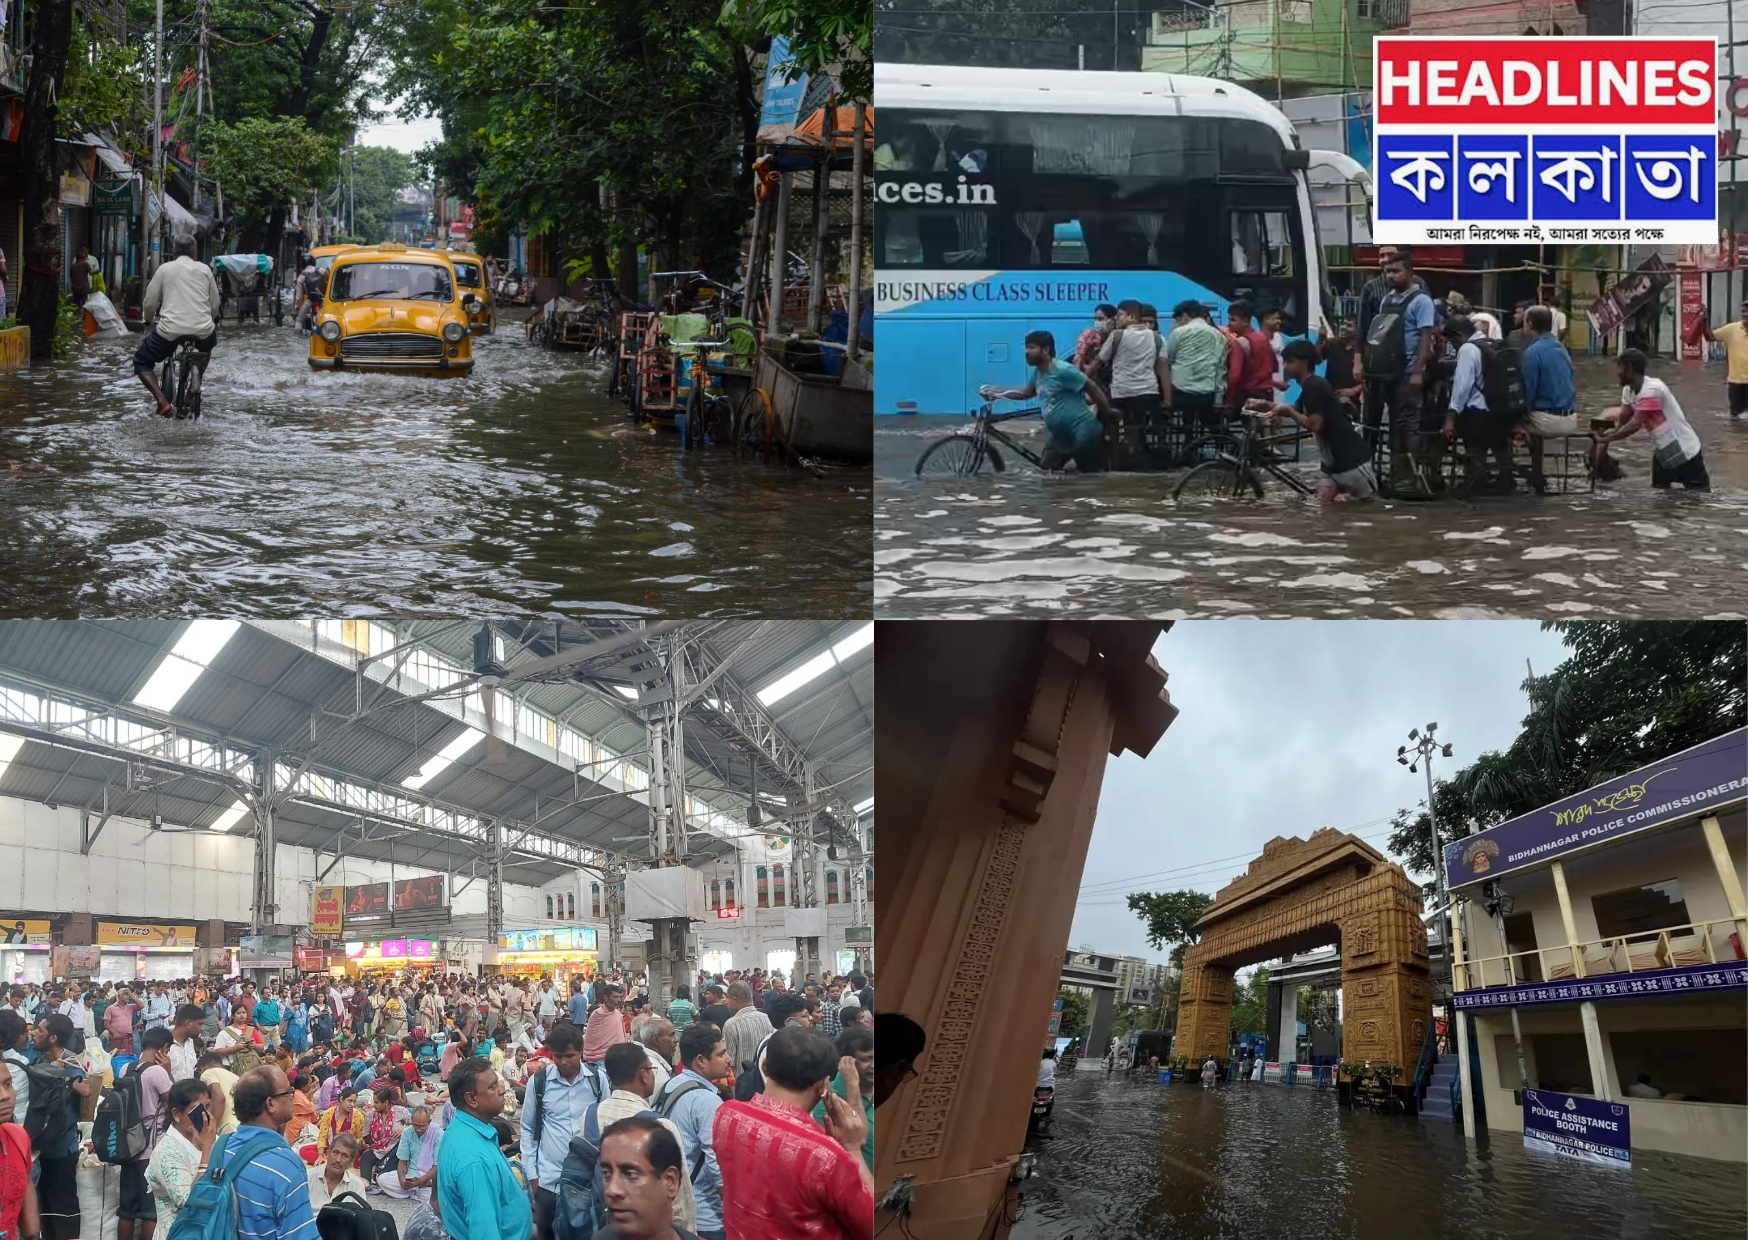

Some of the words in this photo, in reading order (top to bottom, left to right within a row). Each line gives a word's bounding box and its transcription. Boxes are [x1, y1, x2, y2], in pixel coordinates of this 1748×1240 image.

[877, 282, 967, 301] BUSINESS
[972, 282, 1030, 301] CLASS
[1034, 282, 1109, 301] SLEEPER
[1508, 833, 1579, 863] BIDHANNAGAR
[1581, 818, 1624, 839] POLICE
[117, 927, 150, 936] NITRO
[1531, 1106, 1560, 1119] POLICE
[1561, 1112, 1619, 1132] ASSISTANCE
[1556, 1120, 1587, 1134] BOOTH
[1535, 1131, 1584, 1150] BIDHANNAGAR
[1585, 1143, 1614, 1157] POLICE
[1554, 1144, 1580, 1157] TATA
